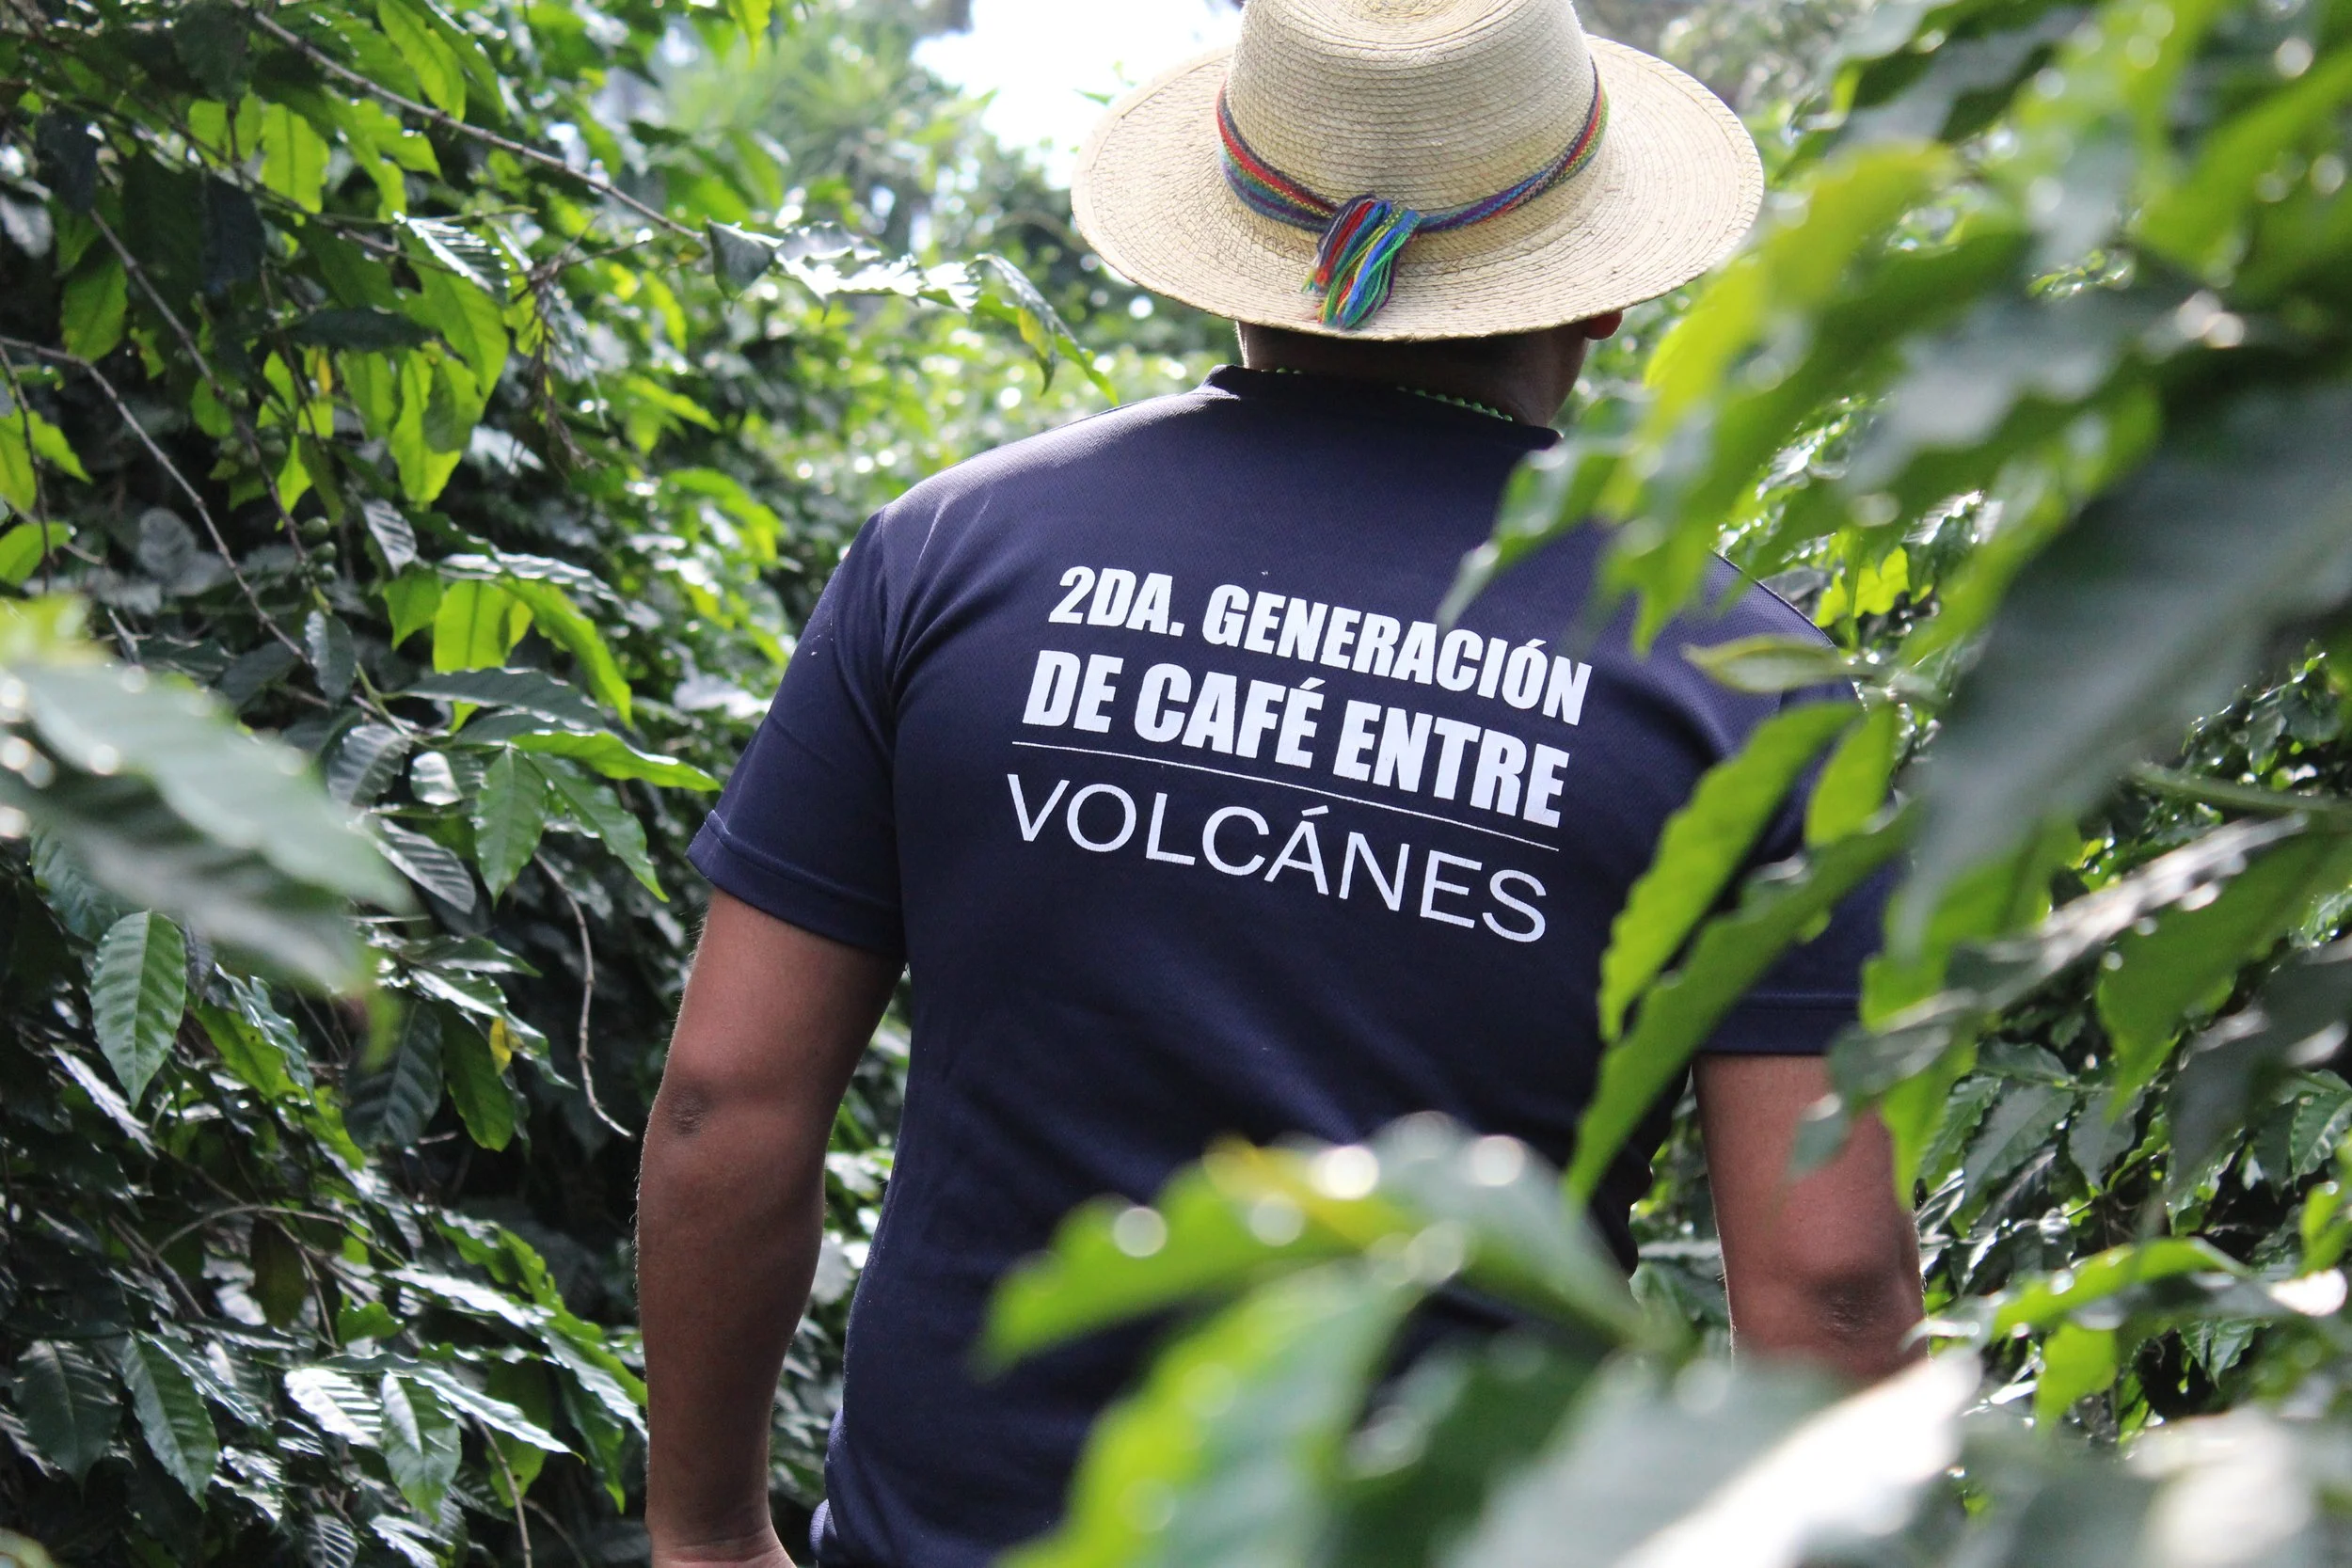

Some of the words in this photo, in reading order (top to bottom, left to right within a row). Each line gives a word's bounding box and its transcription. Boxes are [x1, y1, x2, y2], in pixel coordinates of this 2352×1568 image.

[1047, 565, 1185, 637] 2DA.
[1201, 583, 1593, 726] GENERACIÓN
[1022, 649, 1124, 734] DE
[1134, 662, 1327, 769] CAFÉ
[1332, 699, 1570, 829] ENTRE
[1007, 773, 1548, 942] VOLCÁNES
